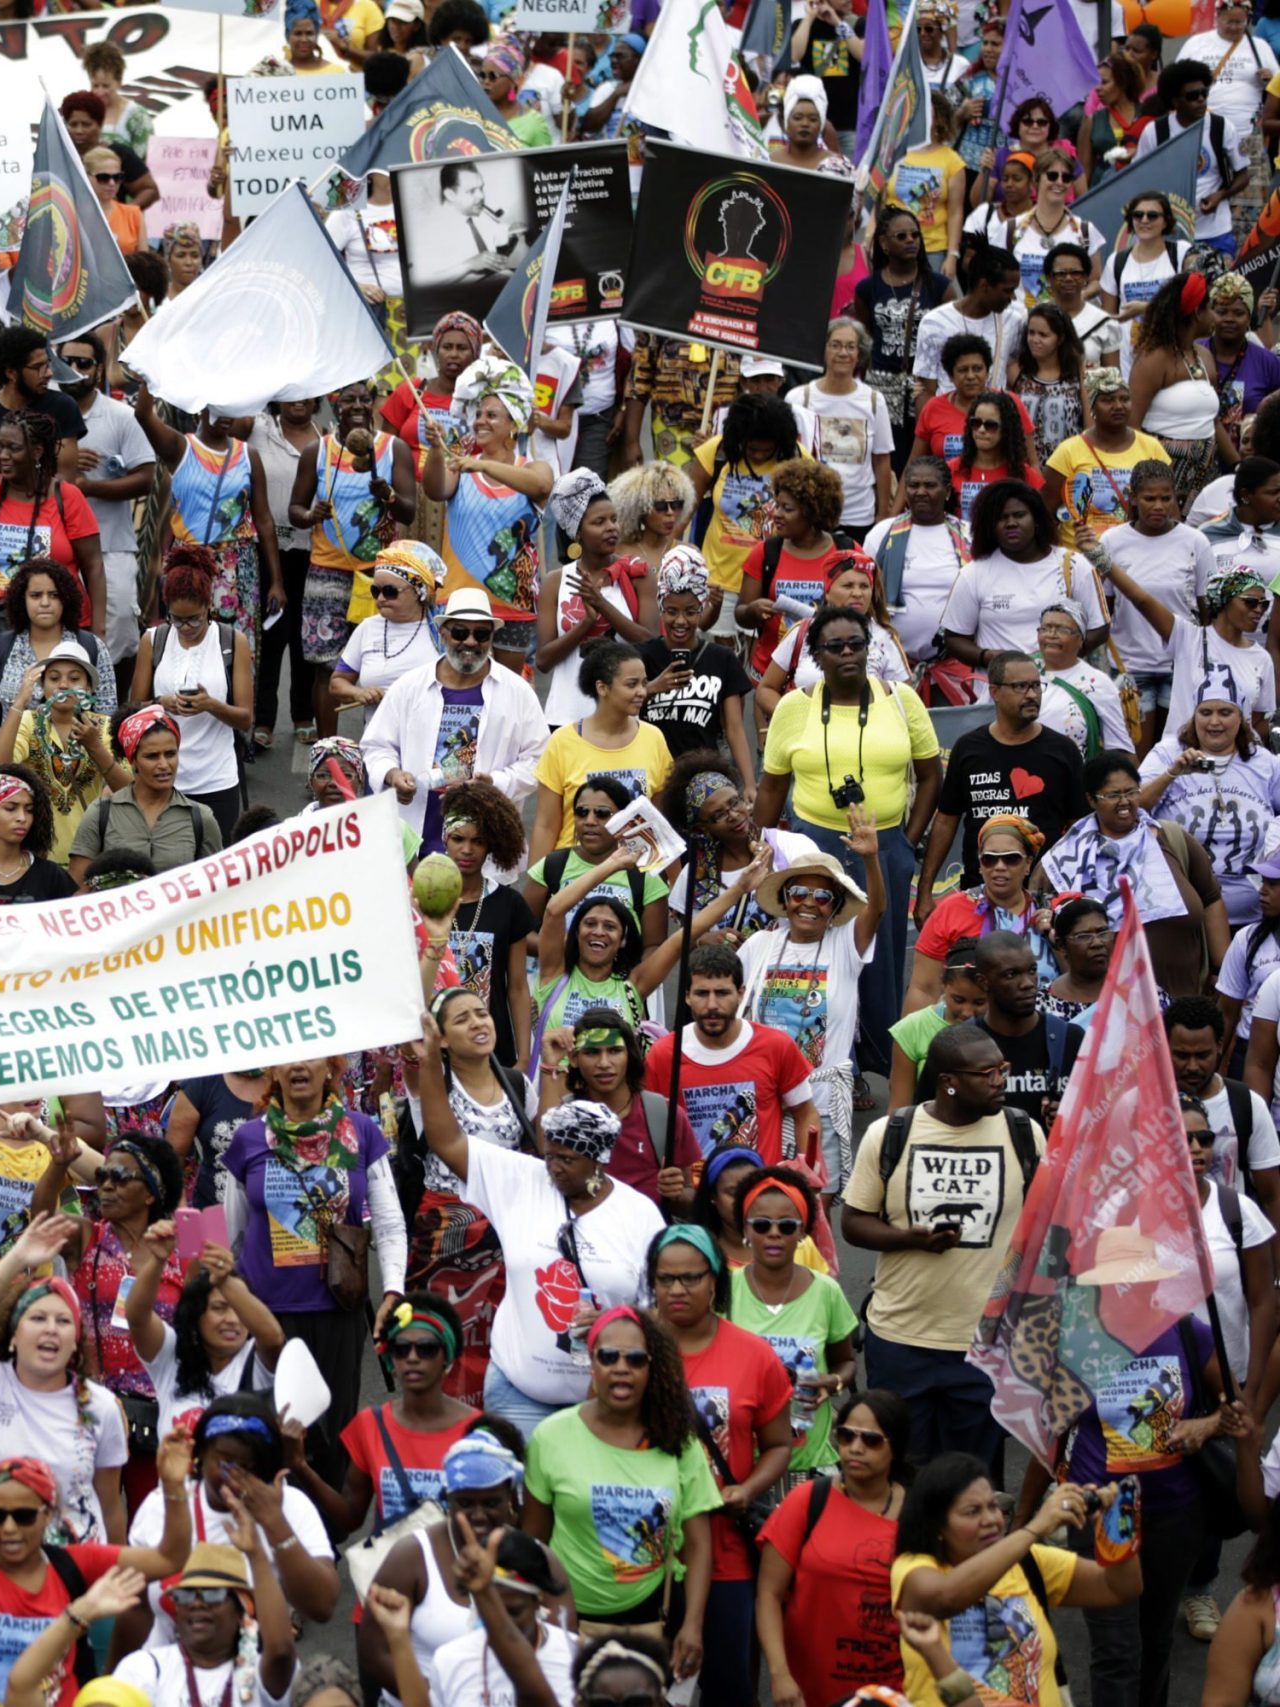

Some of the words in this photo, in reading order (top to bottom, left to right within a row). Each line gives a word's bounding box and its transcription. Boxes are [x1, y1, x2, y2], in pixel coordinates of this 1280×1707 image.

[234, 87, 305, 105] Mexeu
[313, 86, 357, 101] com
[271, 115, 324, 131] UMA
[234, 145, 304, 163] Mexeu
[533, 172, 540, 182] A
[541, 172, 558, 182] luta
[577, 190, 610, 201] classes
[706, 261, 762, 294] CTB
[776, 582, 824, 590] MARCHA
[443, 706, 472, 715] RCHA
[970, 772, 1001, 785] VIDAS
[971, 789, 1010, 801] NEGRAS
[972, 806, 1029, 818] IMPORTAM
[38, 890, 156, 938] NEGRAS
[160, 873, 201, 904] DE
[203, 811, 362, 892] PETRÓPOLIS
[59, 933, 165, 983] NEGRO
[175, 891, 352, 956] UNIFICADO
[109, 991, 158, 1022] DE
[159, 948, 363, 1015] PETRÓPOLIS
[132, 1026, 209, 1067] MAIS
[213, 1005, 337, 1054] FORTES
[684, 1085, 737, 1099] MARCHA
[922, 1157, 992, 1176] WILD
[932, 1179, 981, 1195] CAT
[592, 1486, 655, 1499] MARCHA
